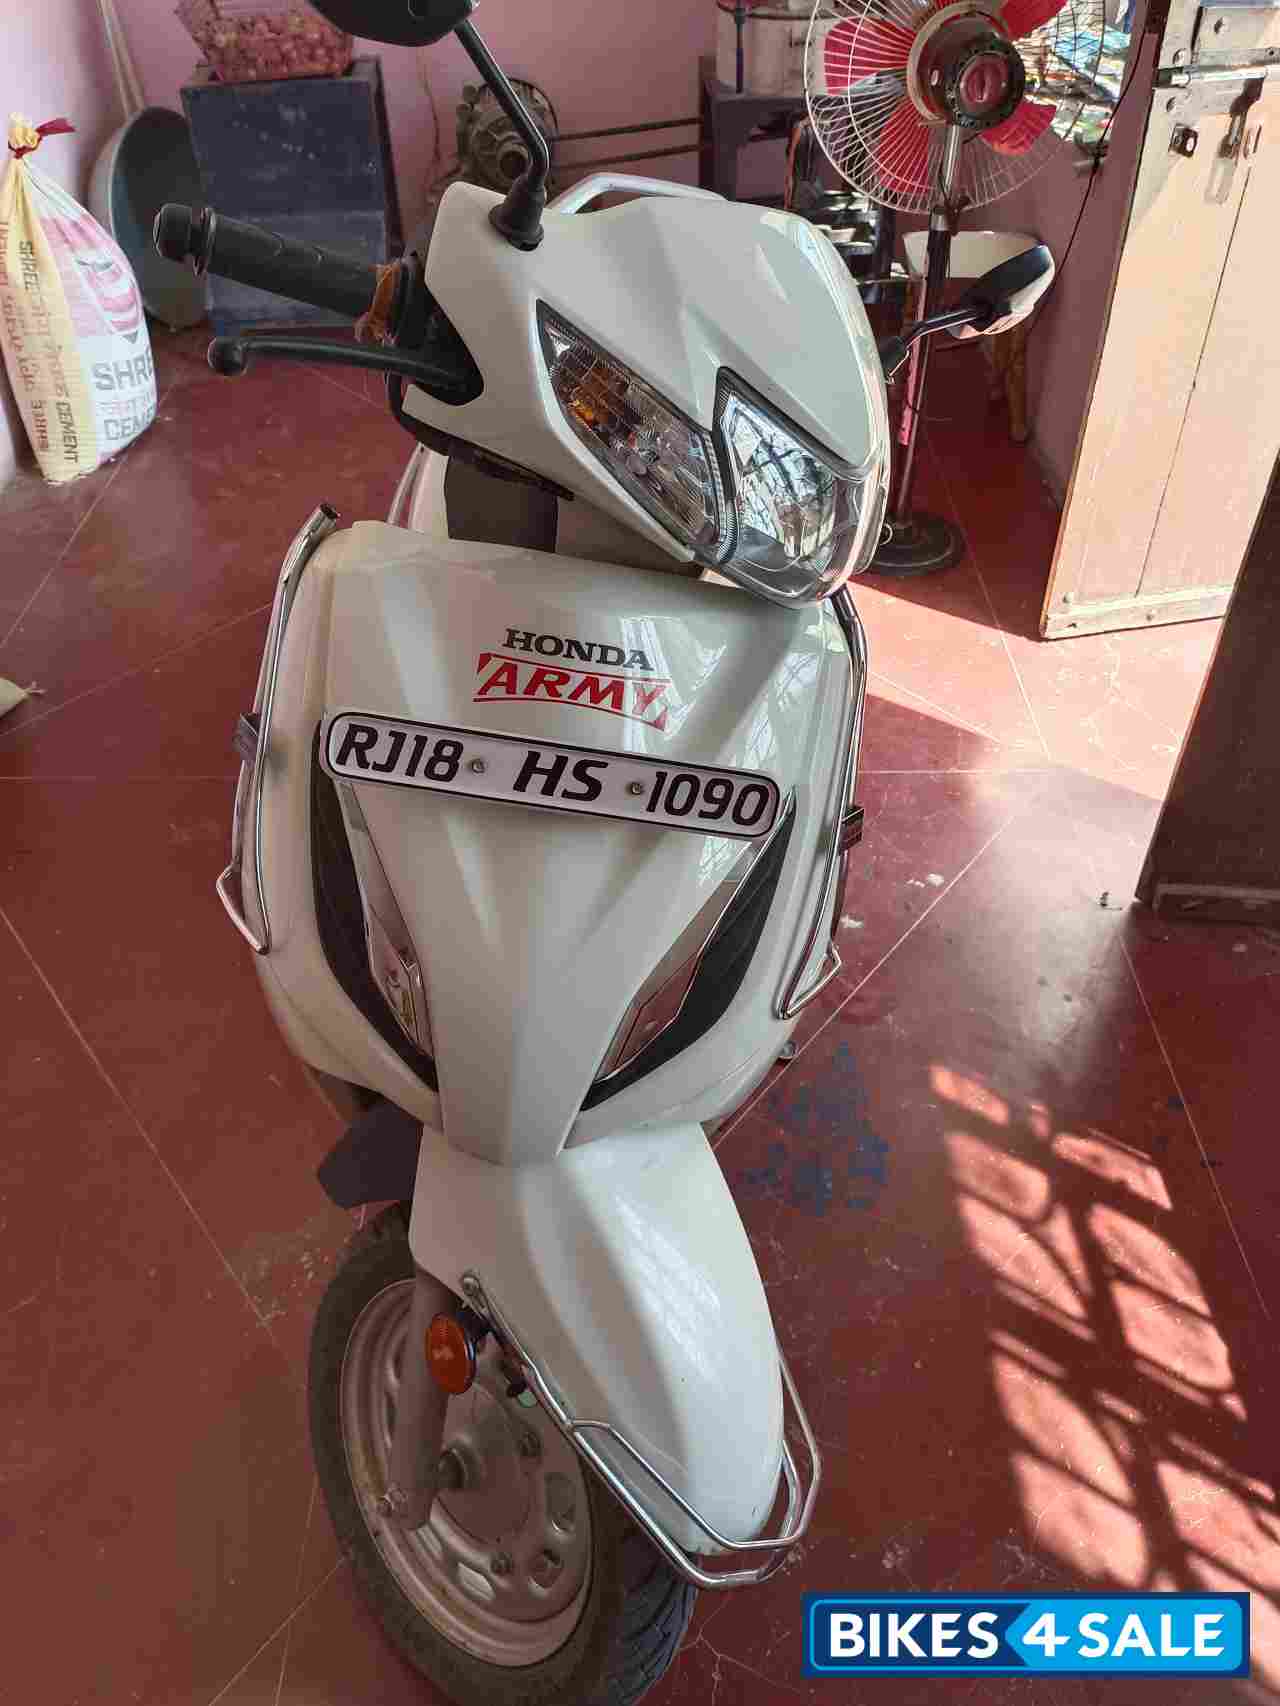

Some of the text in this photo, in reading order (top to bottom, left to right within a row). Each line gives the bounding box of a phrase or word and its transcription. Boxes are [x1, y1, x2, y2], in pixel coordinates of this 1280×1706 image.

[56, 401, 79, 463] CEMENT
[502, 628, 654, 672] HONDA
[477, 661, 666, 717] ARMY
[335, 722, 770, 827] RJ18 HS 1090
